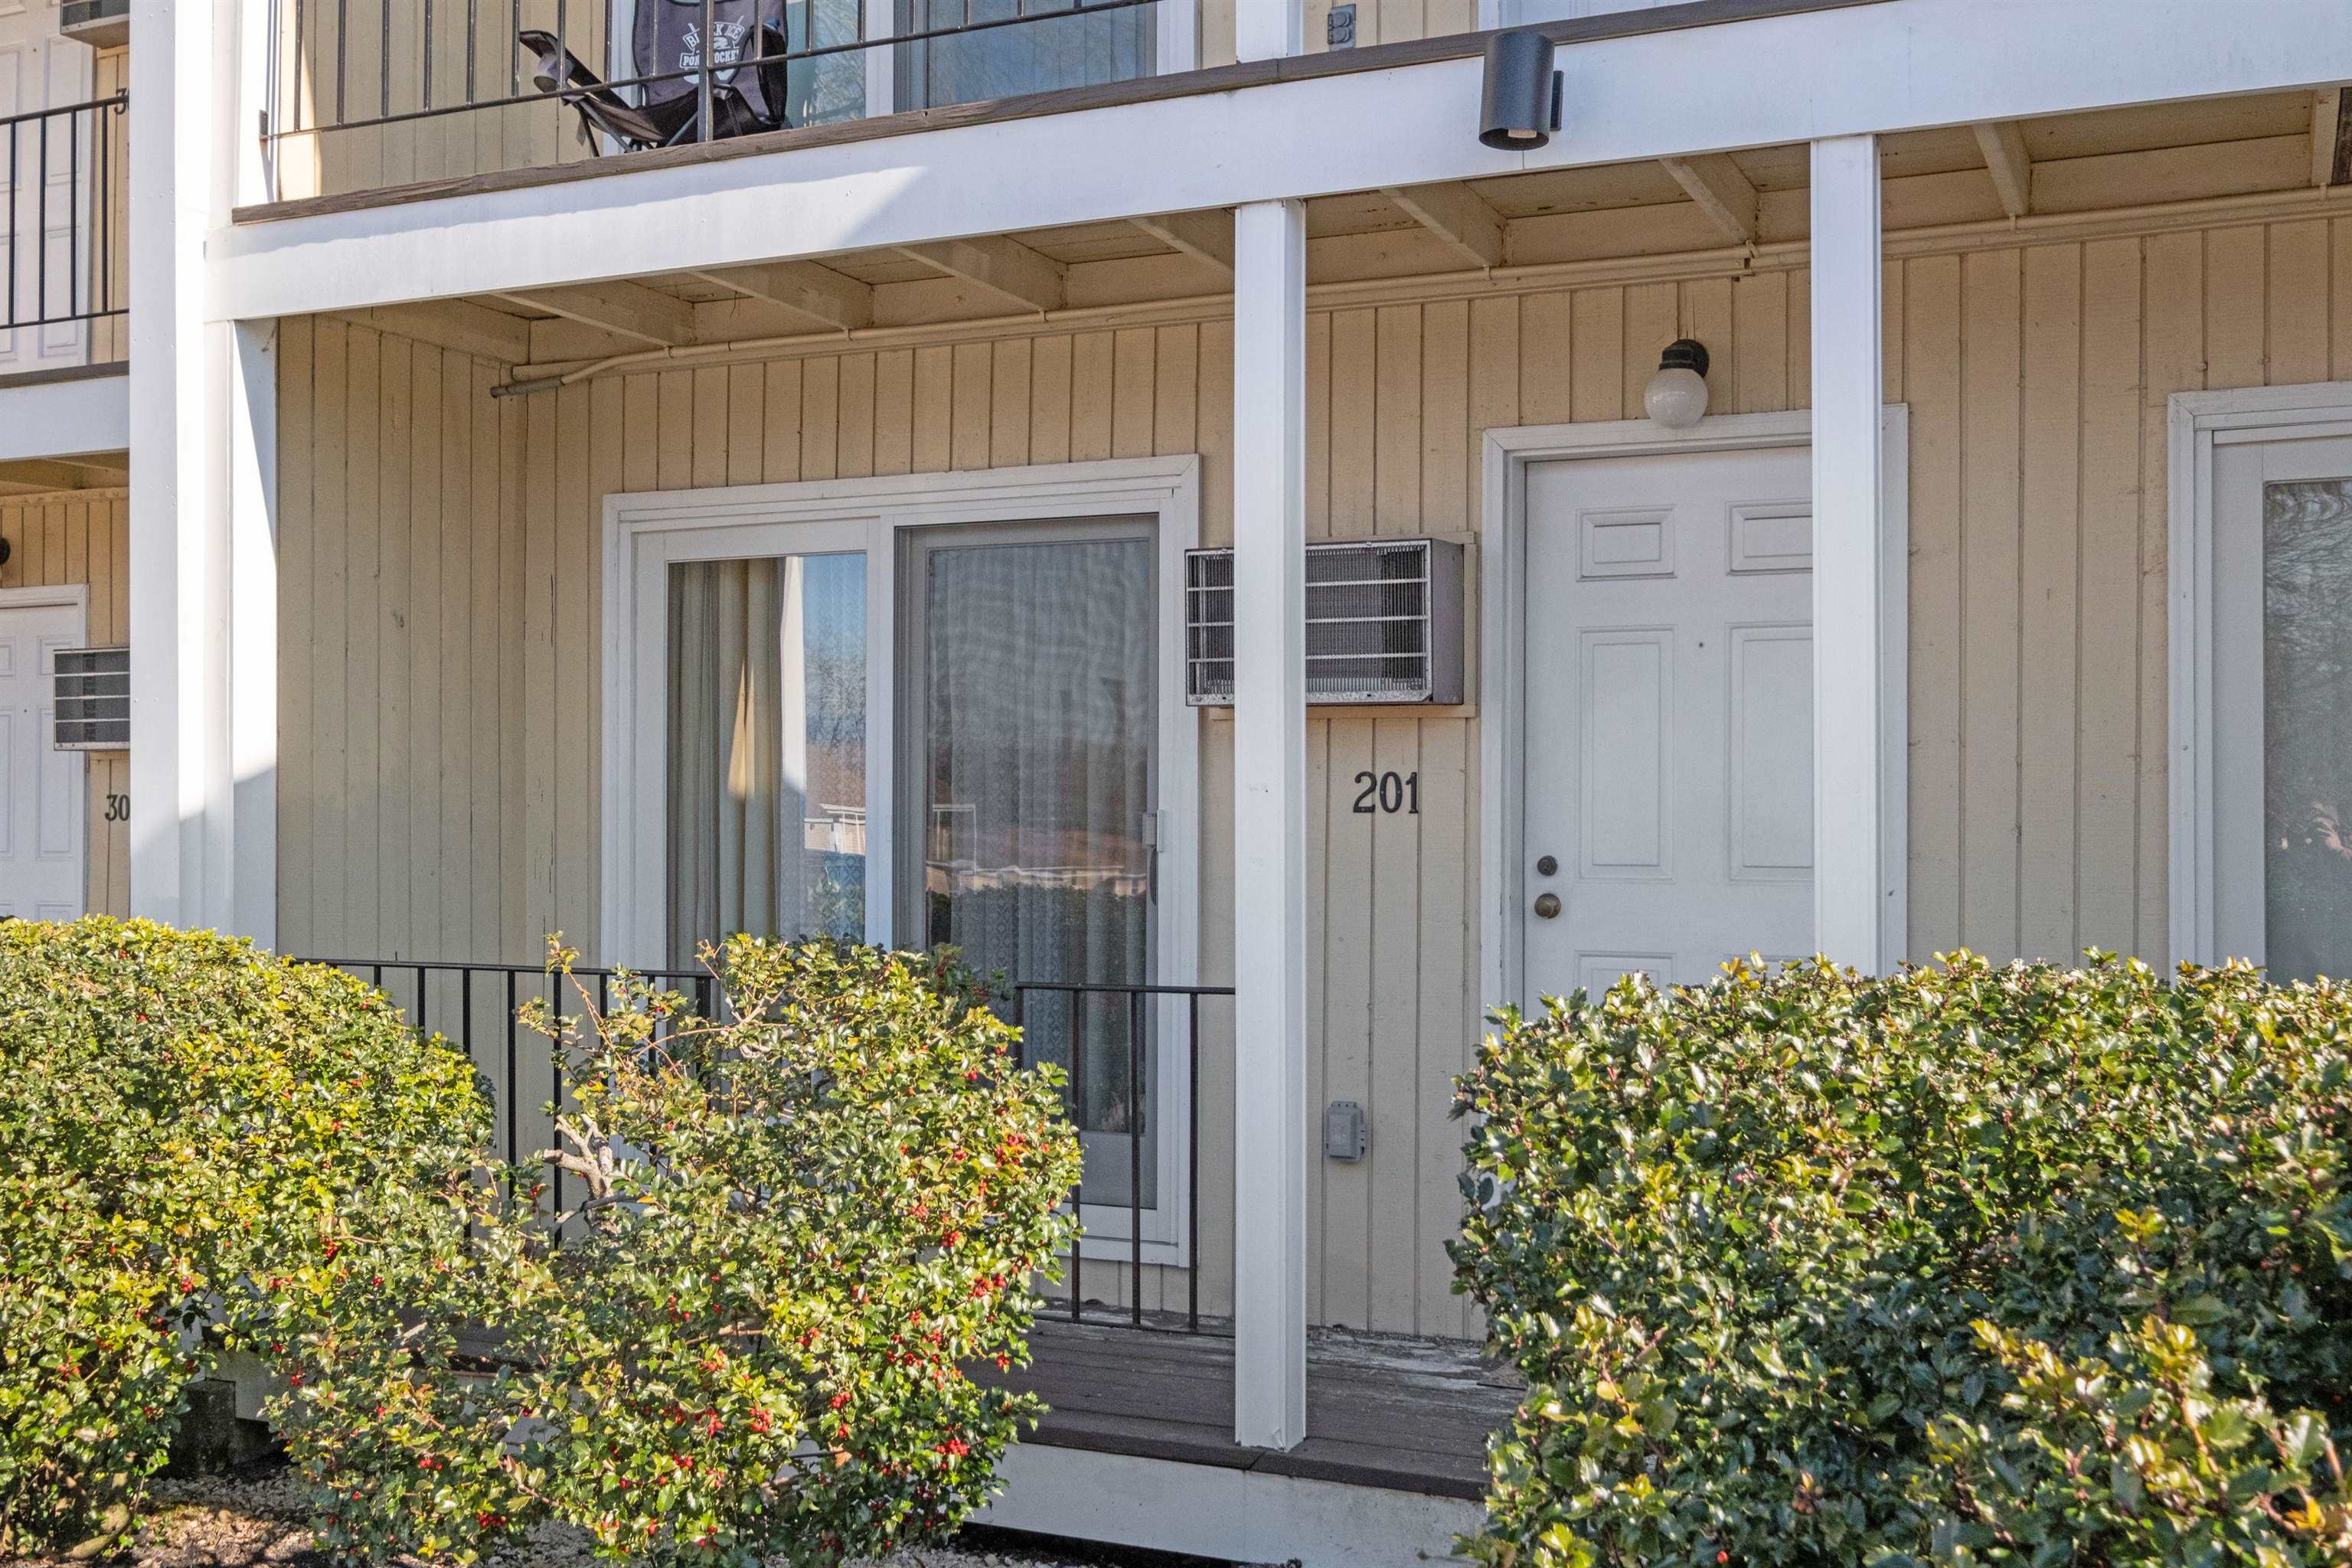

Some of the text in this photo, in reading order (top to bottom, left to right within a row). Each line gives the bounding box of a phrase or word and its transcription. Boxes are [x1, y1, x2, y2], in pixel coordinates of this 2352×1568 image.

[685, 24, 742, 47] BLK ICE
[682, 49, 737, 66] PON OCKE
[1353, 771, 1419, 814] 201
